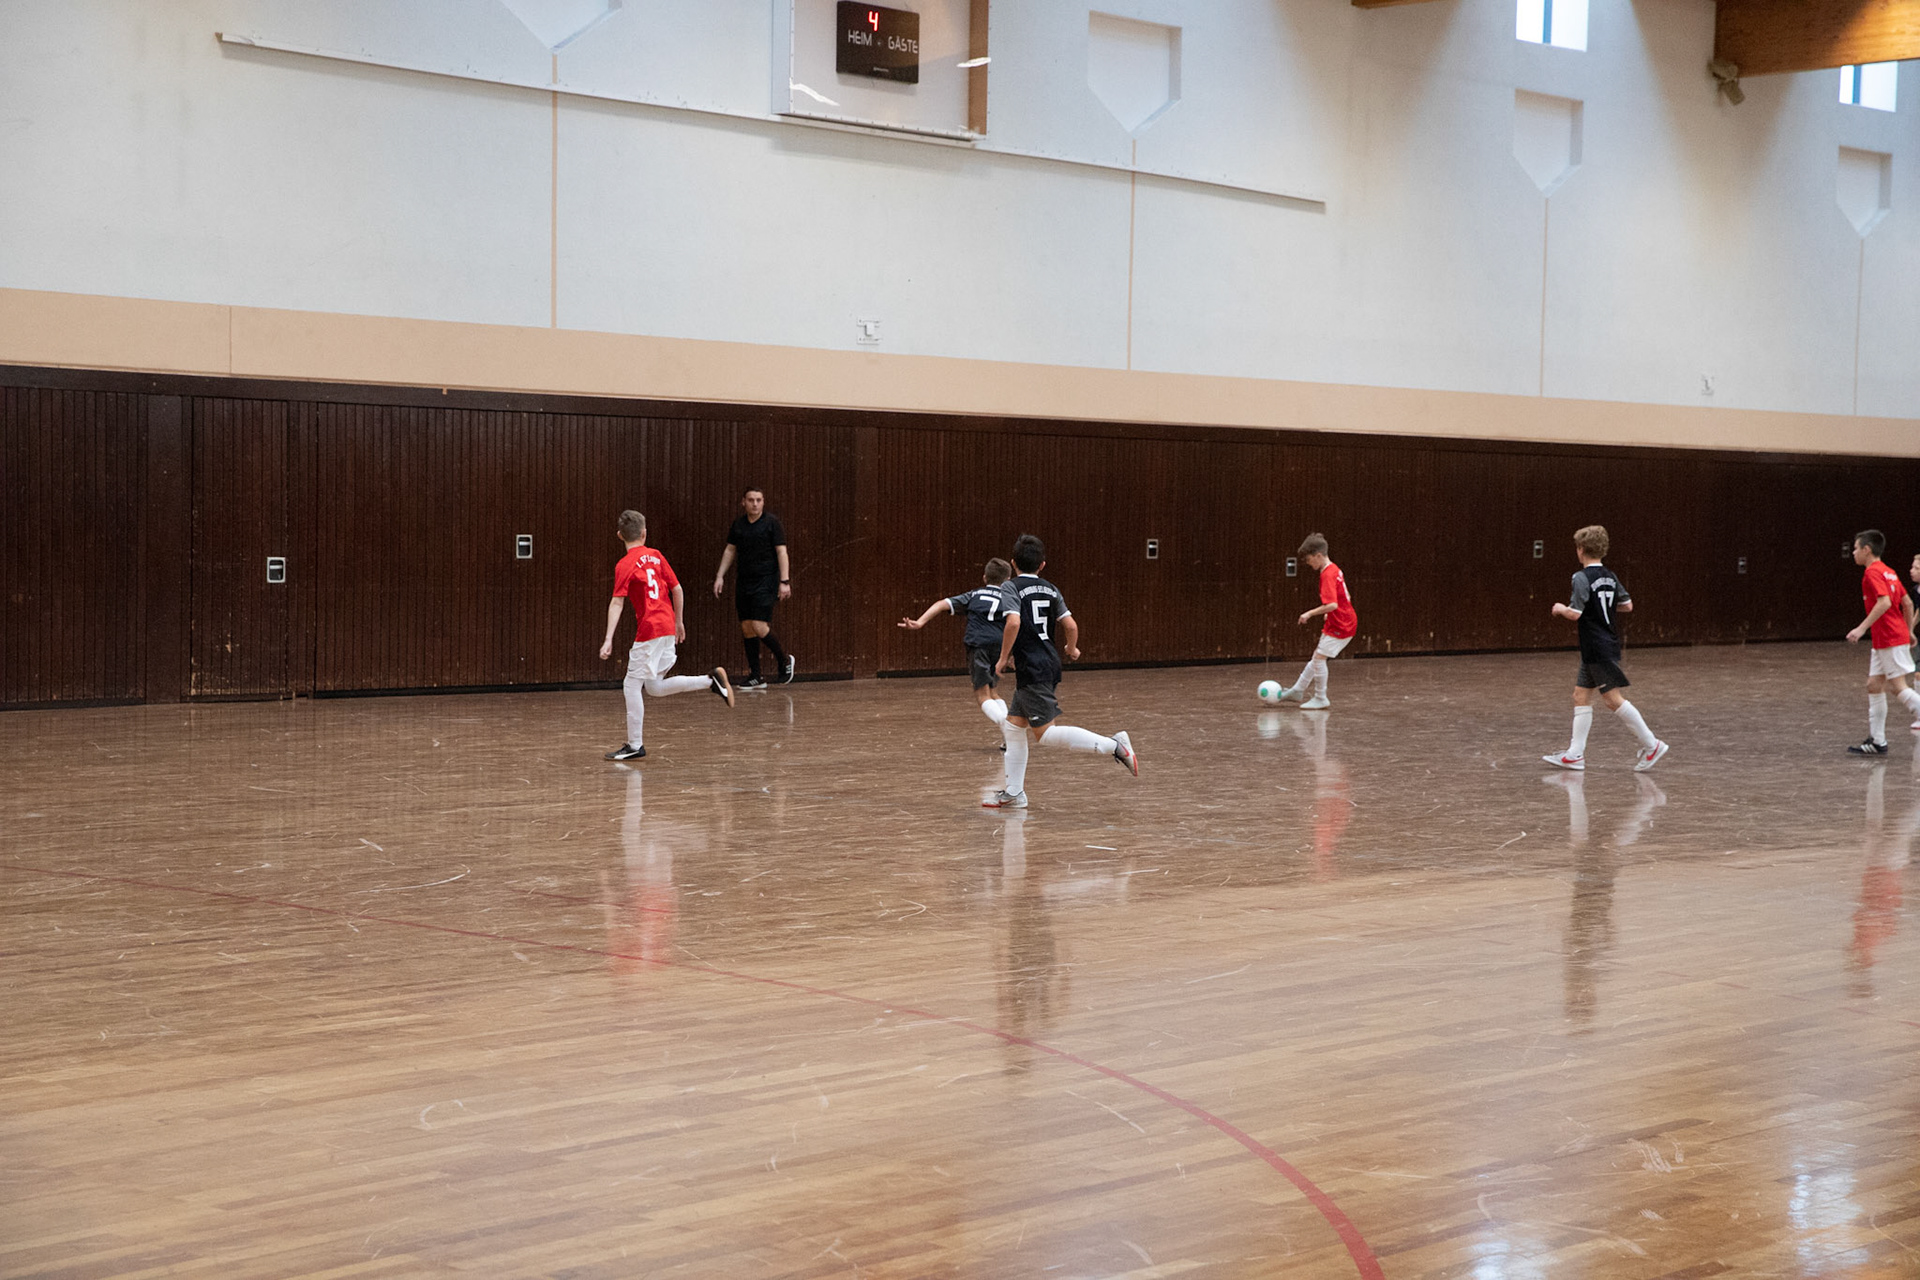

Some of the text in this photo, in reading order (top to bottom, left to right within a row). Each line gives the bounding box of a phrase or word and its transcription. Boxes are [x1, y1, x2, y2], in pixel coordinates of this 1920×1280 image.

[868, 11, 878, 31] 4
[848, 29, 918, 53] HEIM GÄSTE
[645, 568, 660, 600] 5
[979, 595, 1000, 622] 7
[1031, 599, 1051, 641] 5
[1597, 590, 1615, 625] 17
